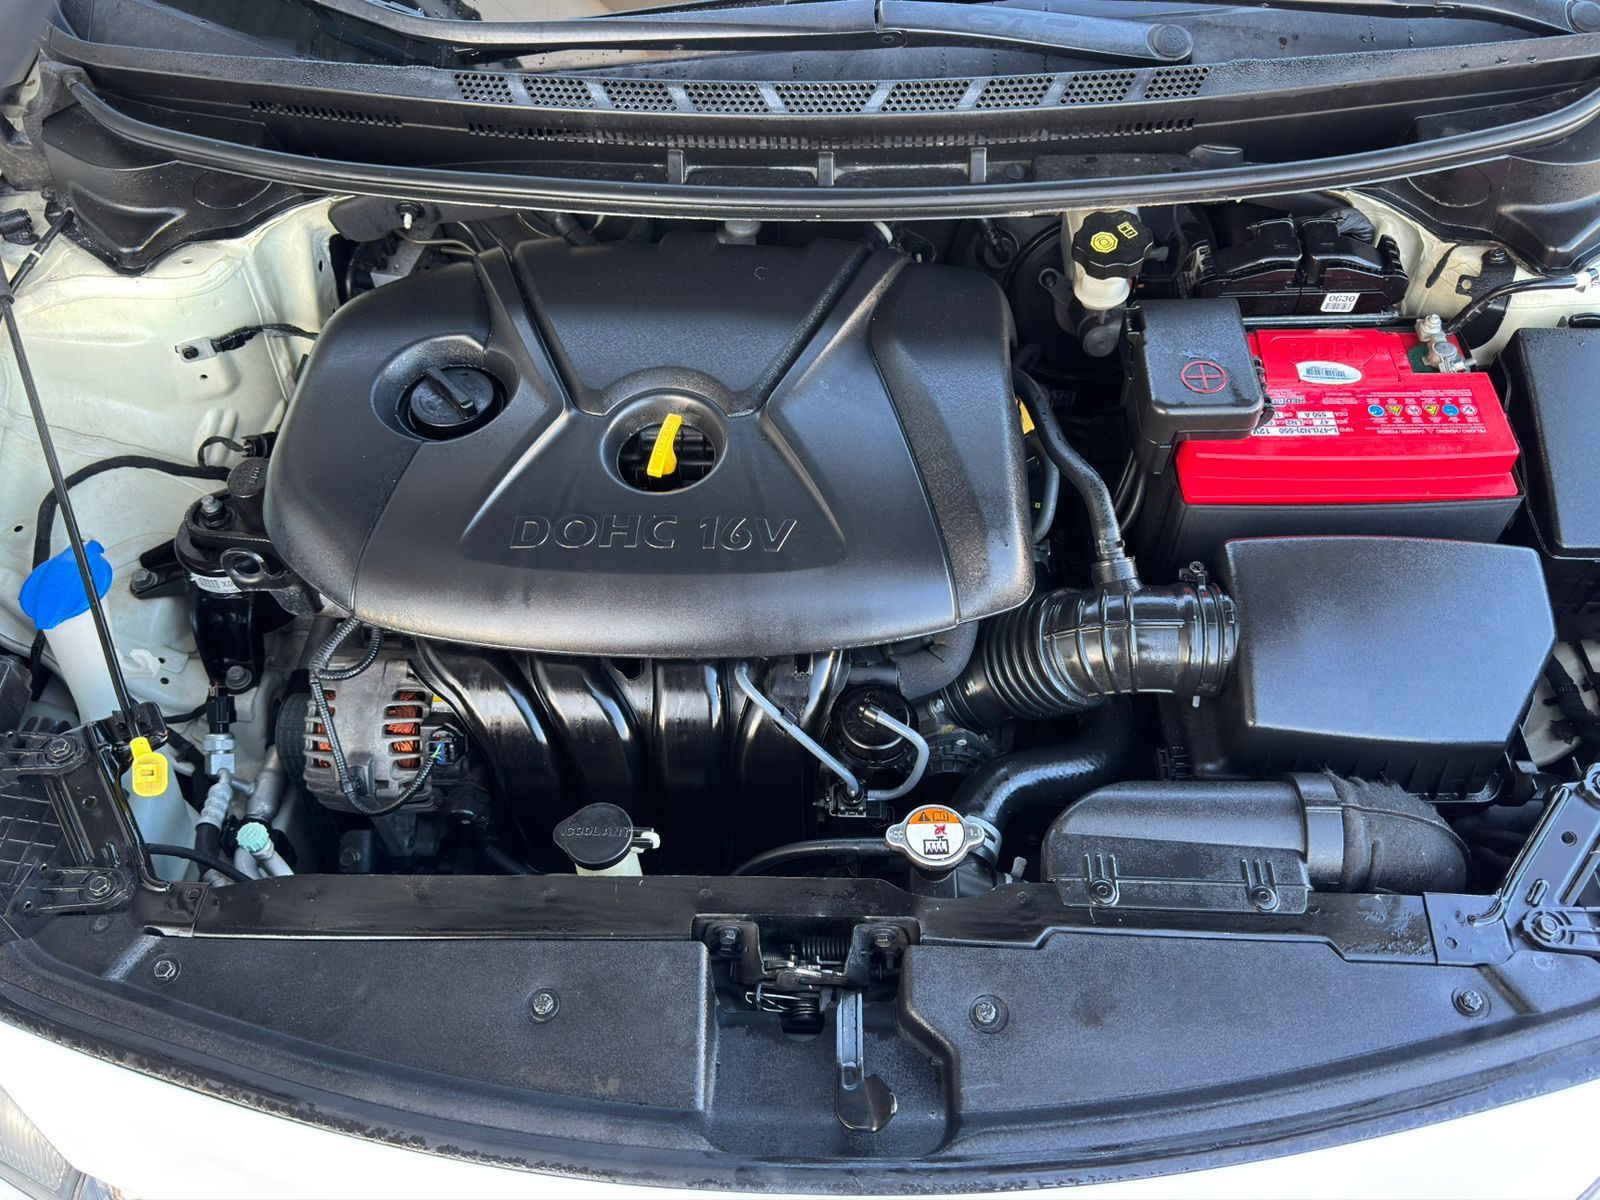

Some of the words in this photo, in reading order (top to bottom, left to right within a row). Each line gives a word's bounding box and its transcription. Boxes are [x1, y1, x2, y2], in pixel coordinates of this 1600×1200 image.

[509, 514, 678, 549] DOHC
[699, 516, 798, 552] 16V
[566, 826, 631, 838] COOLANT
